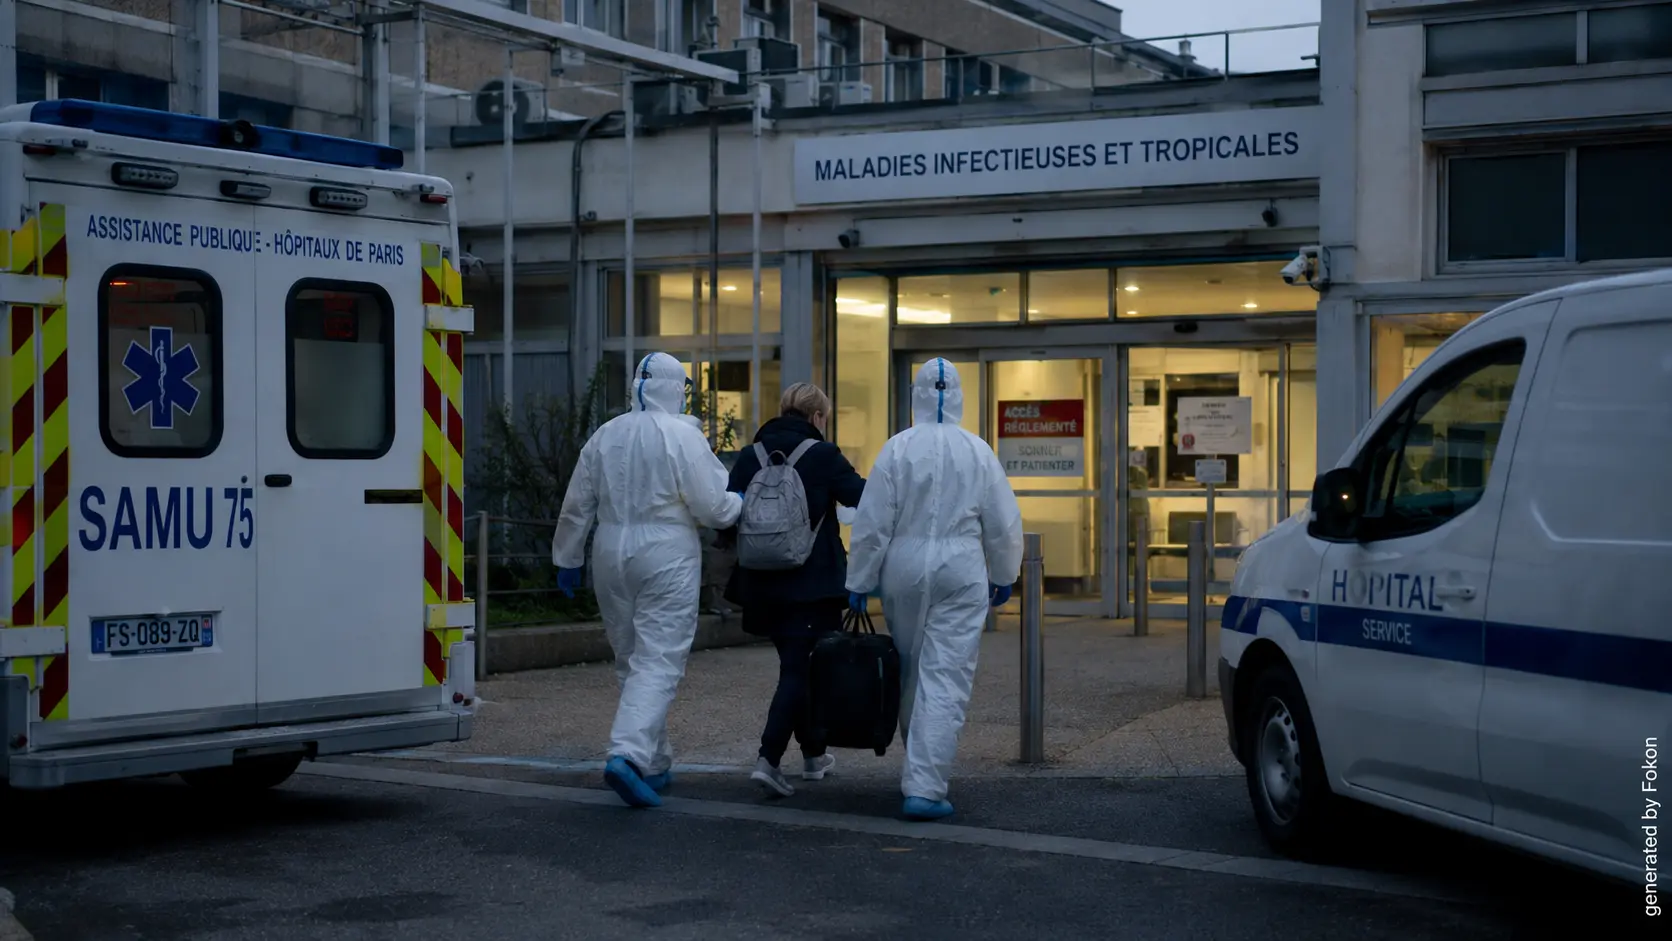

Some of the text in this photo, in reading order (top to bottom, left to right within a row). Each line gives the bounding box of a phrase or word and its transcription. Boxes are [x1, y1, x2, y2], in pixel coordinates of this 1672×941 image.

[815, 131, 1299, 181] MALADIES INFECTIEUSES ET TROPICALES
[87, 214, 182, 245] ASSISTANCE
[190, 224, 261, 253] PUBLIQUE
[274, 228, 340, 260] HÔPITAUX
[346, 240, 363, 262] DE
[369, 242, 404, 265] PARIS
[1006, 460, 1075, 471] ET PATIENTER
[78, 486, 254, 551] SAMU 75
[107, 619, 200, 648] FS-089-ZQ
[1362, 618, 1411, 646] SERVICE
